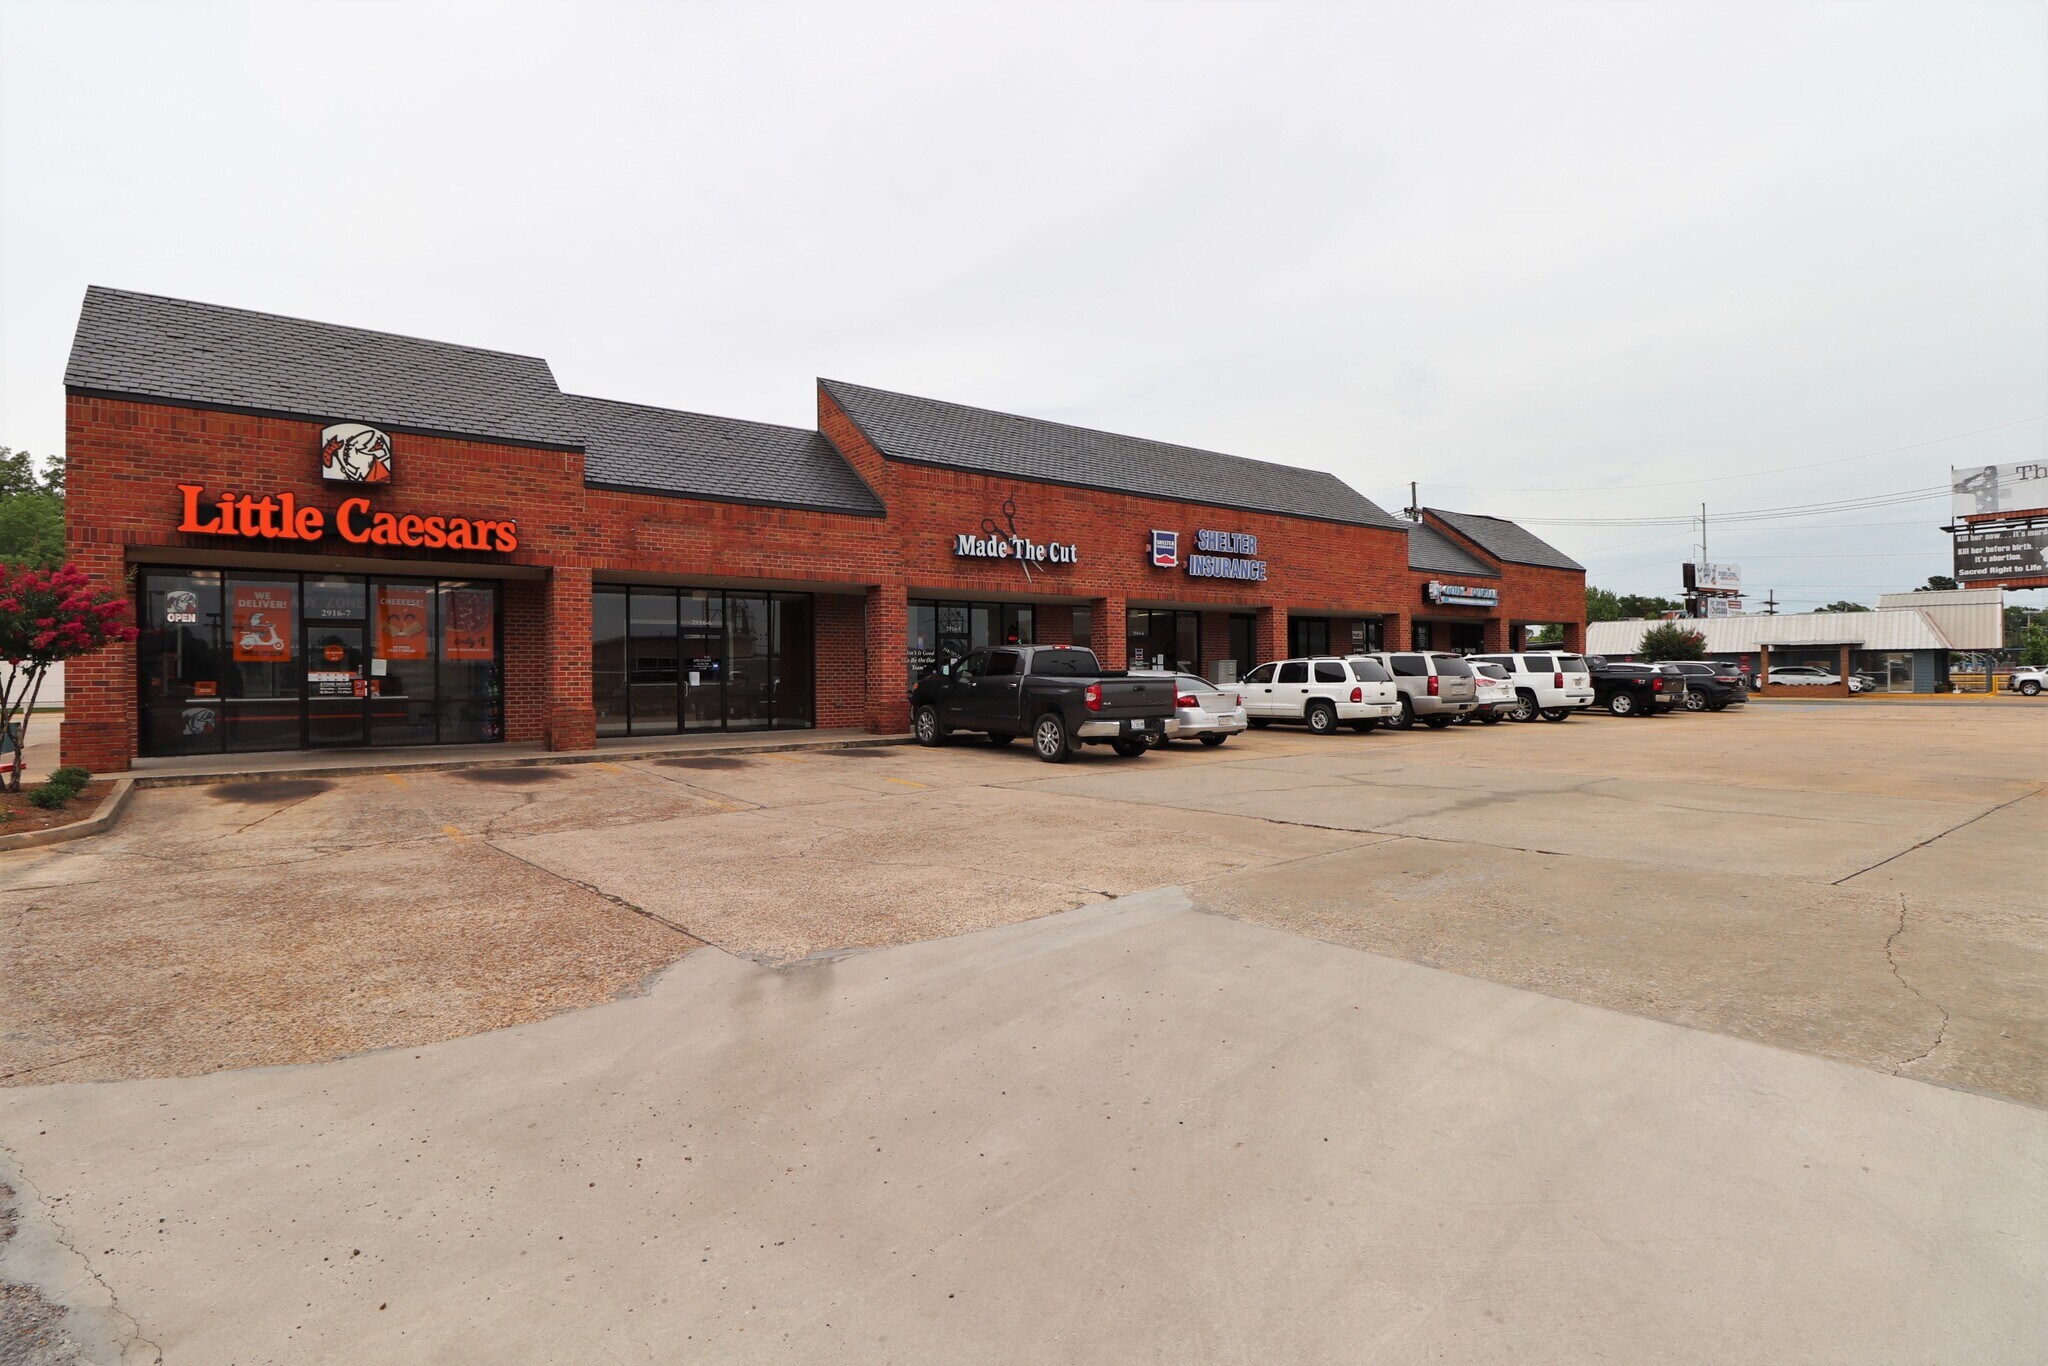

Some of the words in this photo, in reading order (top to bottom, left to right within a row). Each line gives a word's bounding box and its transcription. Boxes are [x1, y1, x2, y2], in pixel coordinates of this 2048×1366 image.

[177, 484, 324, 540] Little
[335, 497, 518, 552] Caesars
[1198, 528, 1257, 555] SHELTER
[1957, 534, 1969, 543] Kill
[1970, 534, 1983, 542] her
[956, 534, 1008, 558] Made
[1010, 537, 1045, 561] The
[1048, 542, 1078, 563] Cut
[1189, 554, 1267, 581] INSURANCE
[1958, 567, 1988, 576] Sacred
[1989, 566, 2013, 574] Right
[2025, 564, 2042, 572] Life
[254, 592, 271, 600] WE
[238, 599, 287, 609] DELIVER!
[167, 613, 196, 623] OPEN
[321, 609, 351, 617] 2916-7
